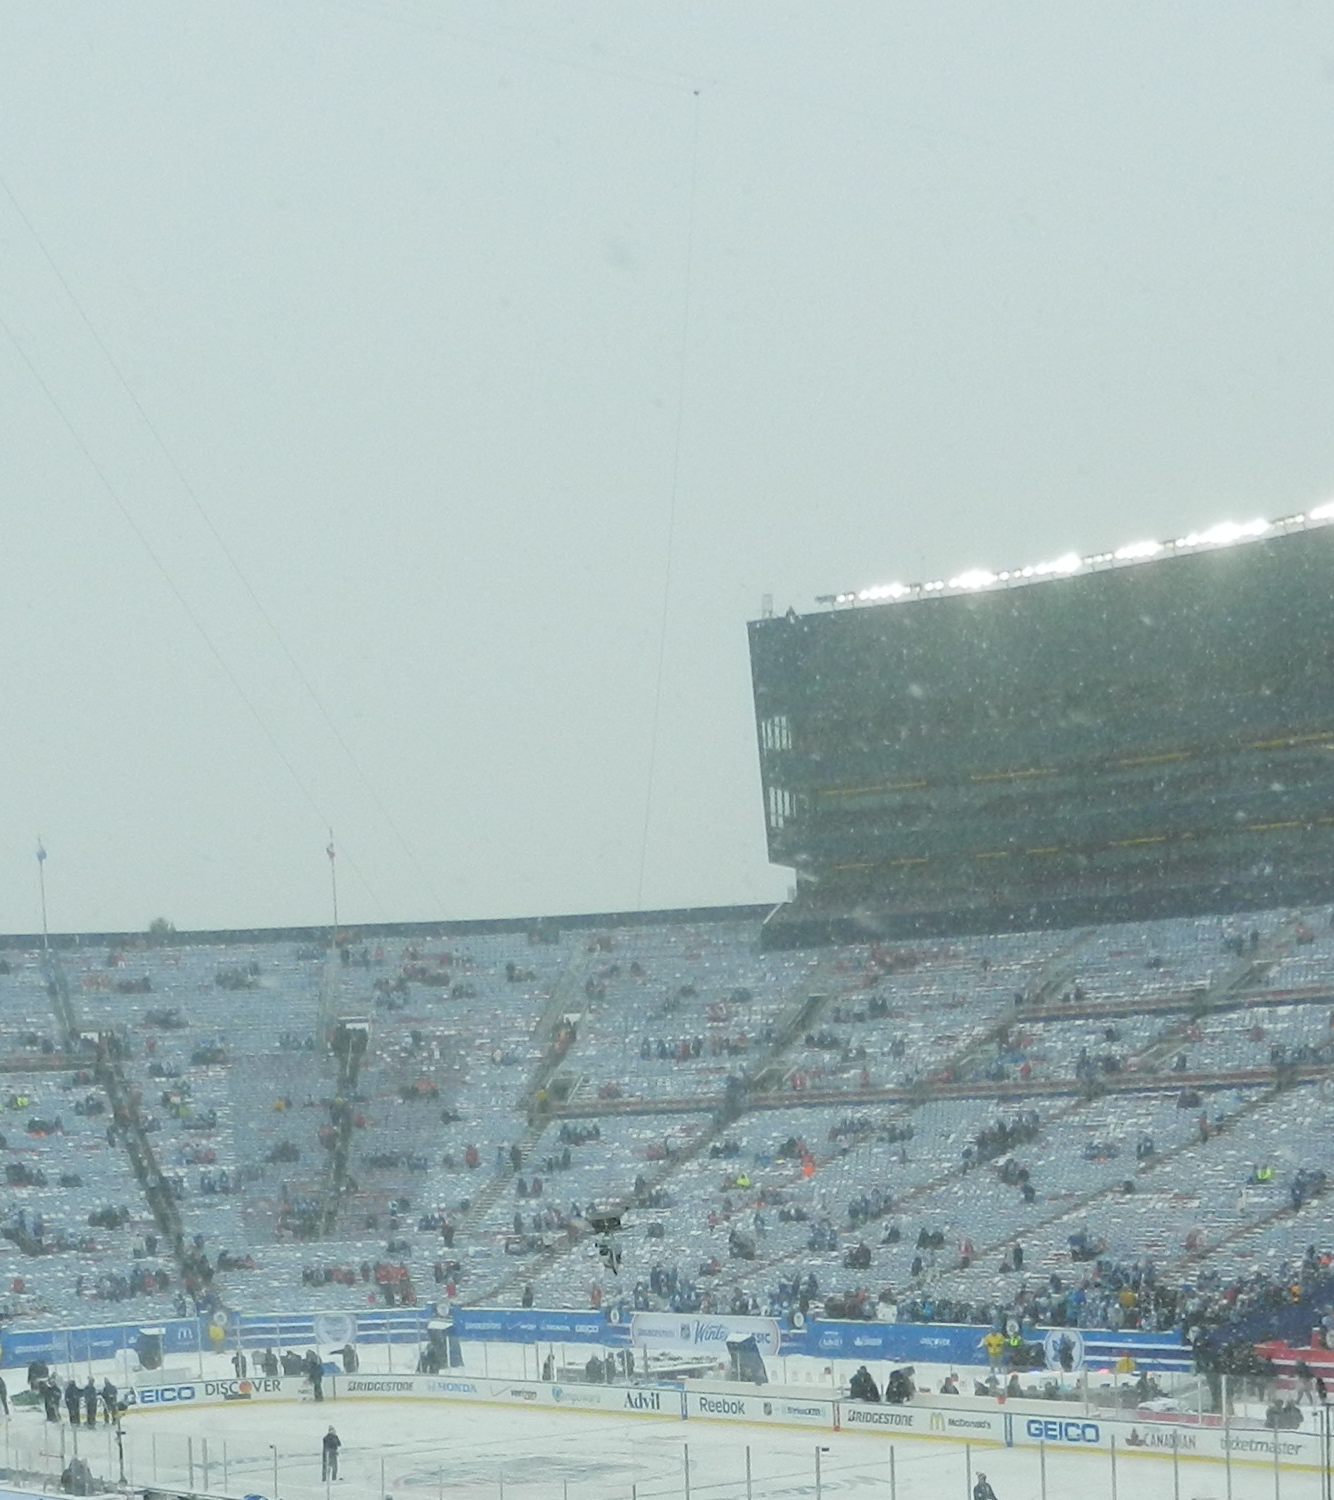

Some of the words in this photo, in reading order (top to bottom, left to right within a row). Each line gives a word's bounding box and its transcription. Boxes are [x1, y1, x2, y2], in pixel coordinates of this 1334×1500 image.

[693, 1319, 728, 1345] Winte
[205, 1379, 281, 1397] DISCOVER
[347, 1381, 415, 1392] BRIDGESTONE
[436, 1382, 477, 1393] HONDA
[624, 1392, 660, 1410] Advil
[699, 1397, 746, 1415] Reebok
[847, 1409, 914, 1426] BRIDGESTONE
[948, 1417, 992, 1430] McDonald's
[1026, 1419, 1101, 1442] GEICO
